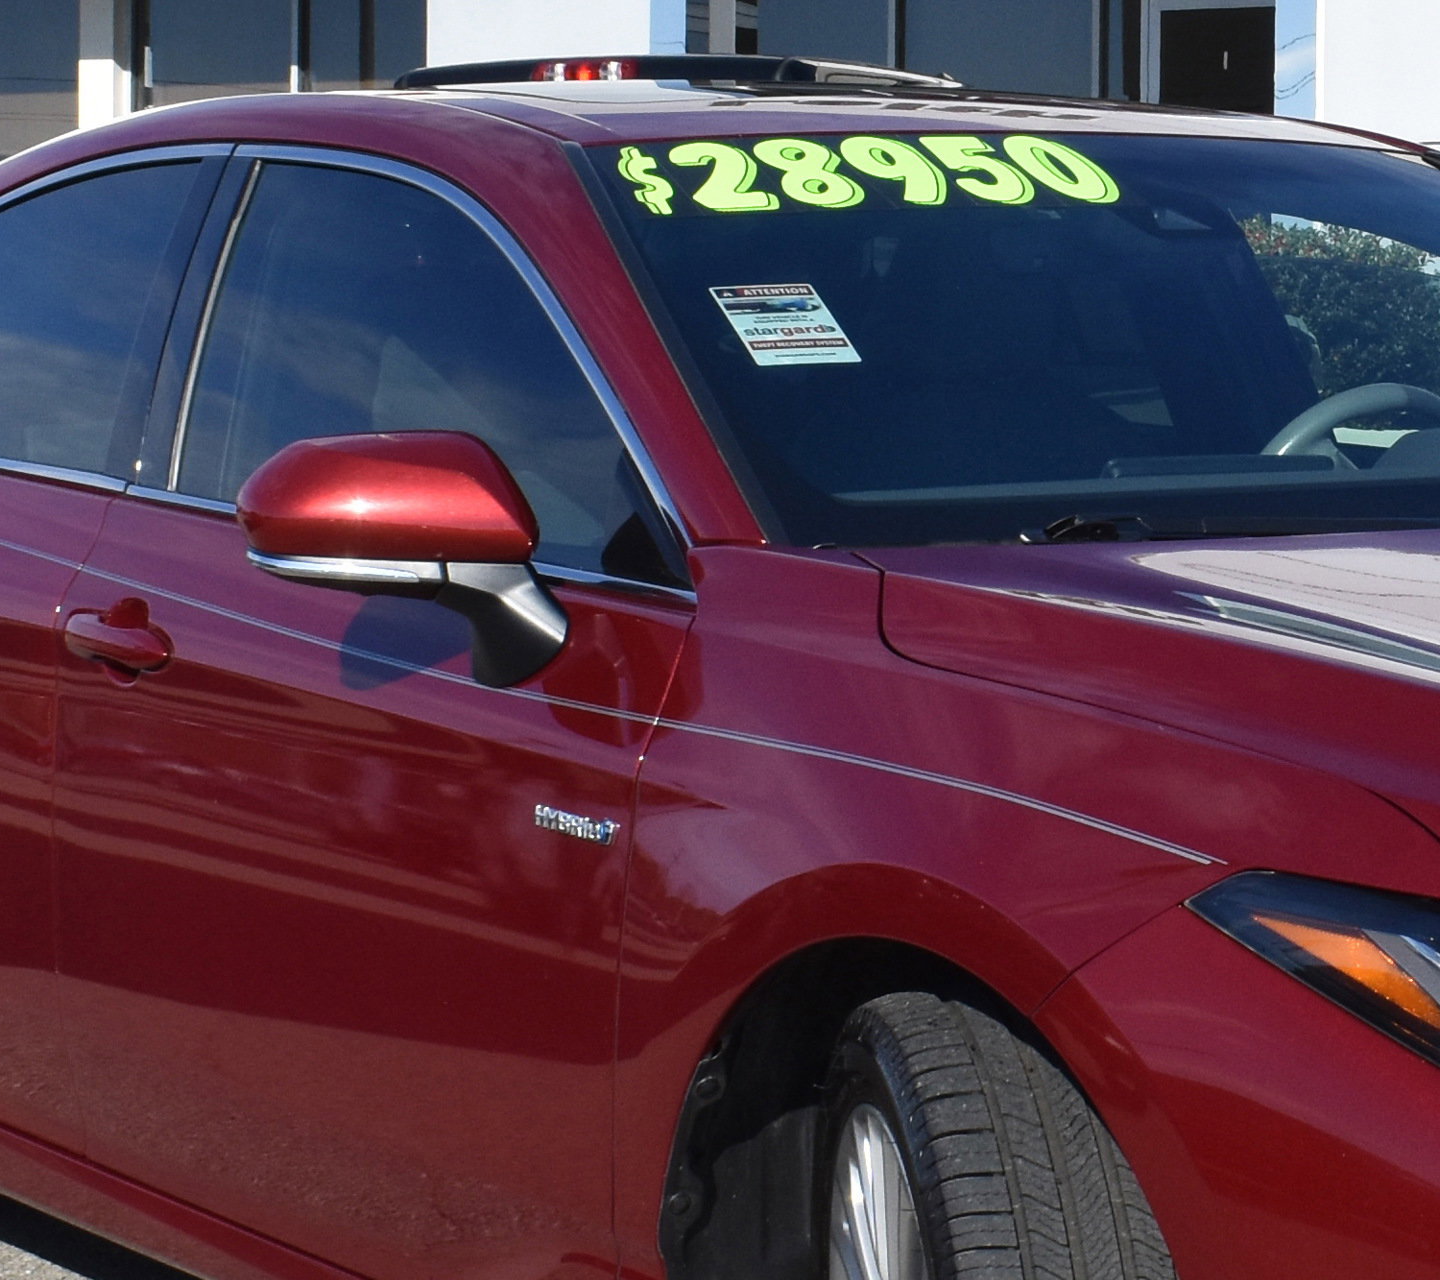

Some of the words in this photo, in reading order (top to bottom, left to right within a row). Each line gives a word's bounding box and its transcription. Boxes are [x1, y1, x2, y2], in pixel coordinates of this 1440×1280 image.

[617, 135, 1120, 215] $28950
[743, 287, 809, 297] ATTENTION
[743, 323, 827, 337] stargard
